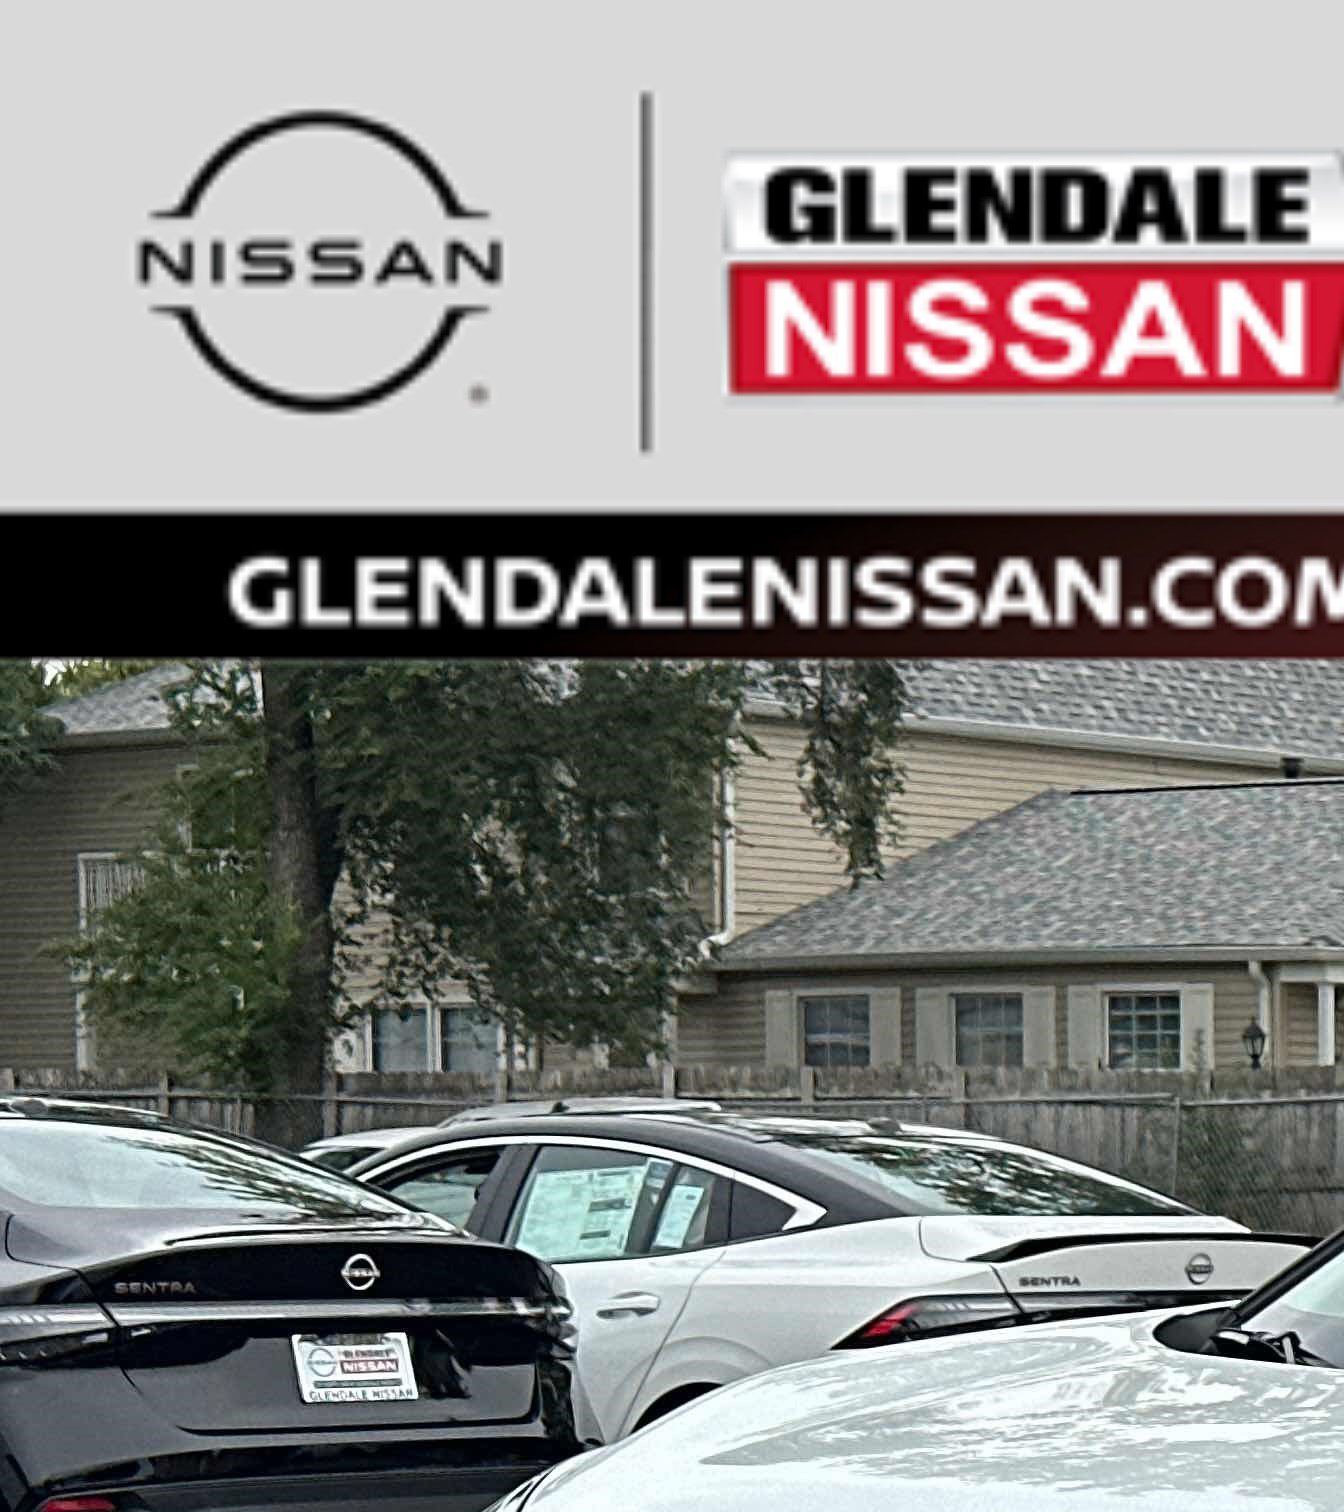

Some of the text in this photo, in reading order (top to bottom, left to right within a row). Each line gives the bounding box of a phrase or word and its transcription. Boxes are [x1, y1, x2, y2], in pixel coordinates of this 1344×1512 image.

[1019, 1274, 1081, 1287] SENTRA
[114, 1281, 196, 1294] SENTRA
[343, 1361, 397, 1372] NISSAN
